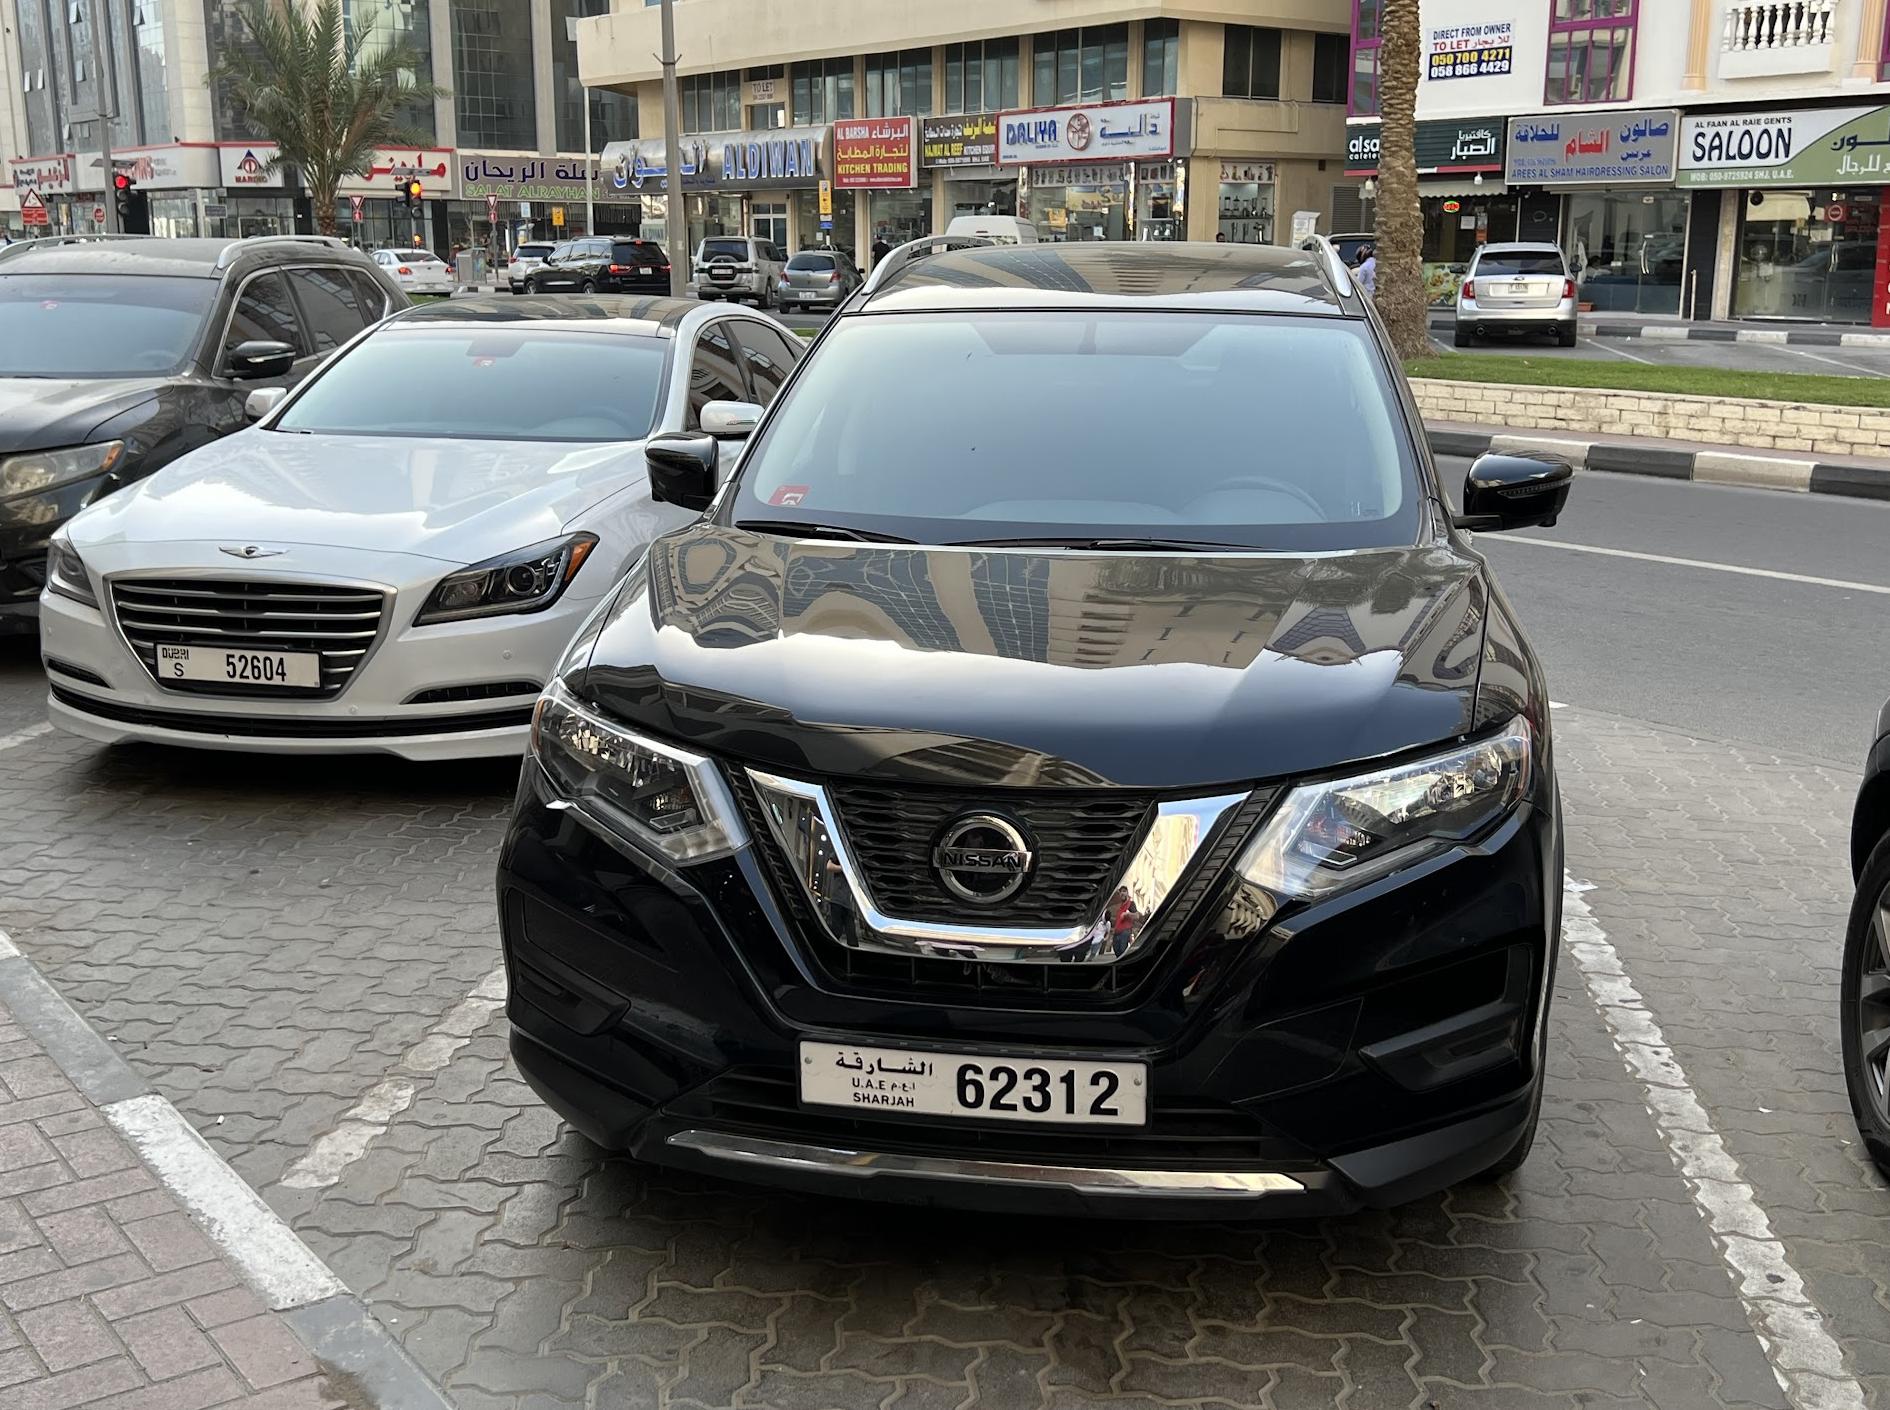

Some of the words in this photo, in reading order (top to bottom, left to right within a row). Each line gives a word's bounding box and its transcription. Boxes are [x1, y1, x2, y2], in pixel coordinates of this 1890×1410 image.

[1433, 29, 1459, 40] DIRECT
[1462, 27, 1481, 37] FROM
[1484, 24, 1511, 35] OWNER
[1433, 41, 1447, 51] TO
[1450, 39, 1470, 50] LET
[1430, 65, 1454, 78] 058
[1480, 59, 1510, 73] 4429
[1431, 53, 1455, 66] 050
[1006, 119, 1057, 145] DALIYA
[1620, 118, 1669, 143] صالون
[1694, 121, 1705, 129] AL
[1729, 119, 1740, 127] AL
[1763, 116, 1792, 125] GENTS
[1450, 136, 1496, 160] الصبار
[1693, 128, 1792, 161] SALOON
[722, 138, 815, 180] ALDIWAN
[837, 164, 871, 175] KITCHEN
[873, 162, 908, 173] TRADING
[465, 159, 546, 183] الريحان
[1538, 168, 1549, 177] AL
[1550, 166, 1574, 177] SHAM
[1575, 165, 1637, 176] HAIRDRESSING
[1639, 164, 1669, 175] SALON
[518, 186, 600, 200] ALRAYHAN
[174, 662, 185, 677] S
[226, 653, 287, 682] 52604
[943, 852, 1022, 872] NISSAN
[835, 1051, 933, 1077] الشارقة
[851, 1077, 887, 1091] U.A.E
[955, 1062, 1120, 1117] 62312
[853, 1091, 915, 1108] SHARJAH
